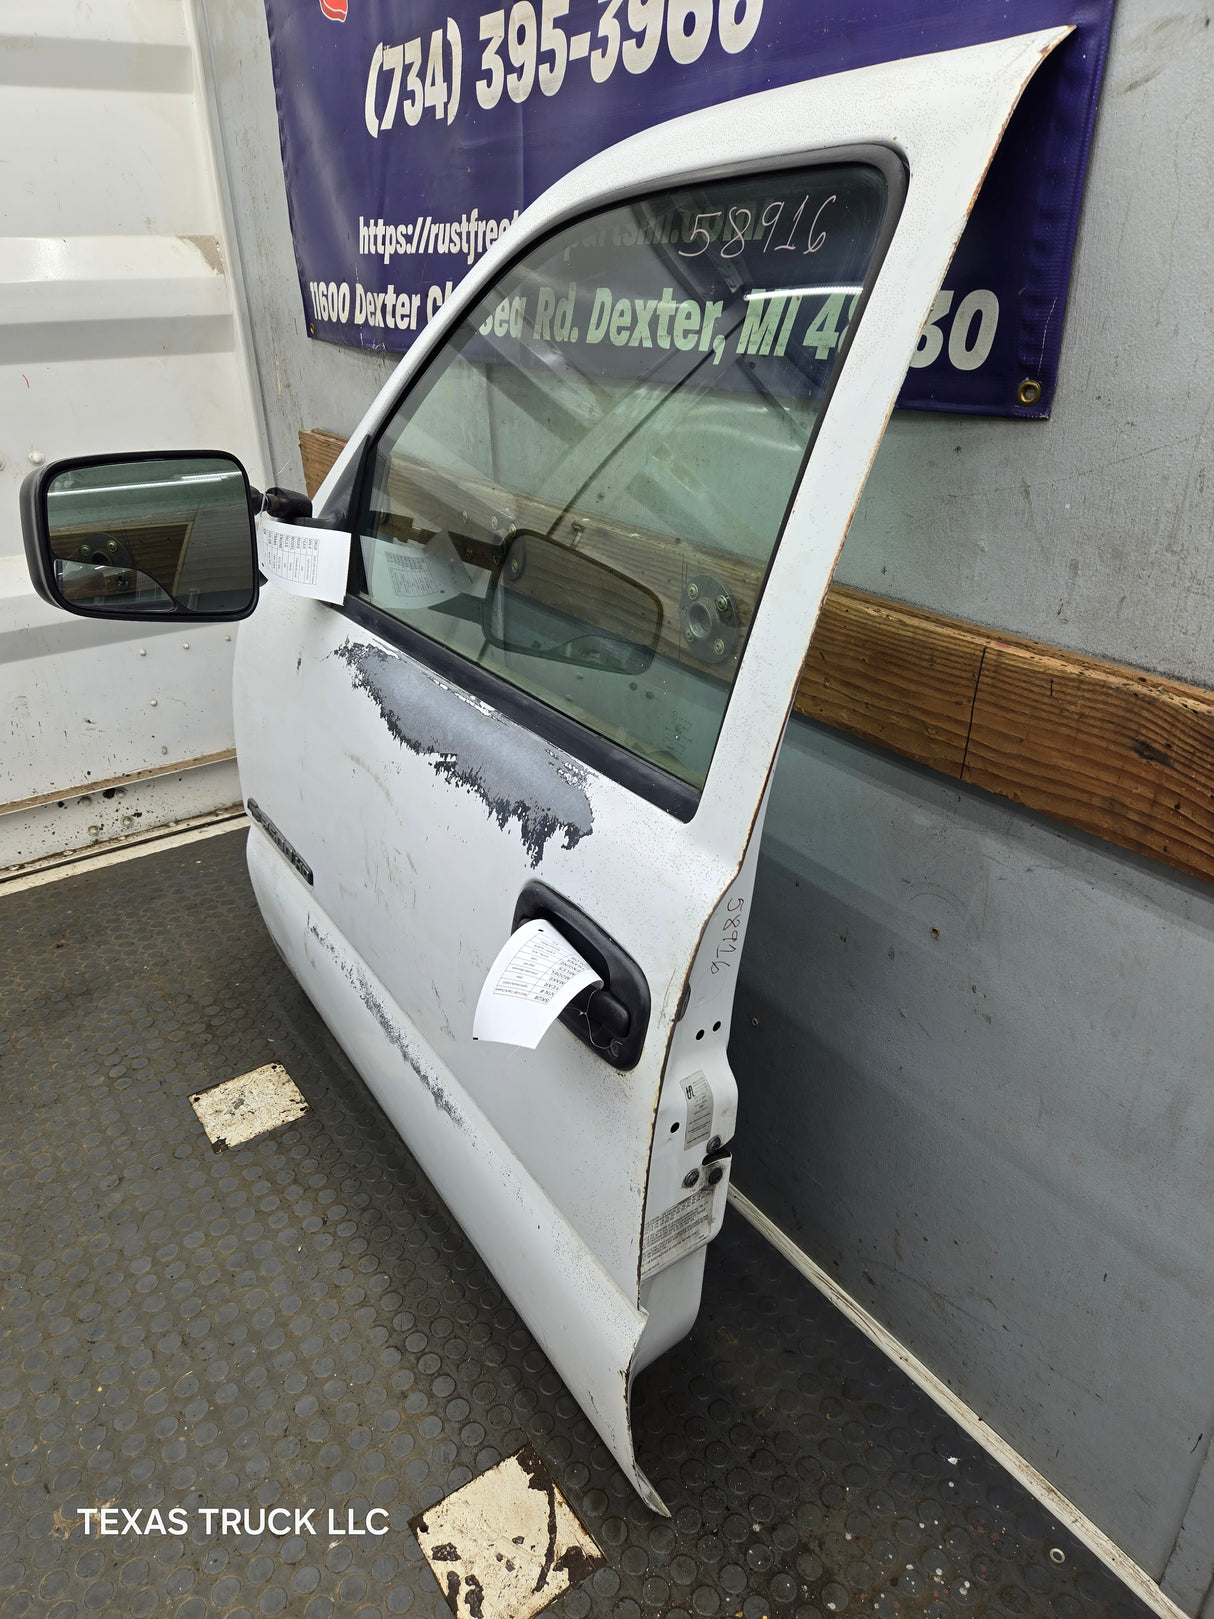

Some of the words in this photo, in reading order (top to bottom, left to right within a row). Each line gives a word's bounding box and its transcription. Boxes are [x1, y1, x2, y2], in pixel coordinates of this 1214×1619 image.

[364, 16, 463, 139] (734)
[678, 194, 837, 259] 58916
[309, 281, 350, 325] 11600
[354, 283, 421, 331] Dexter
[532, 281, 579, 343] Rd.
[585, 287, 727, 366] Dexter,
[736, 288, 801, 358] MI
[710, 897, 745, 975] 58916
